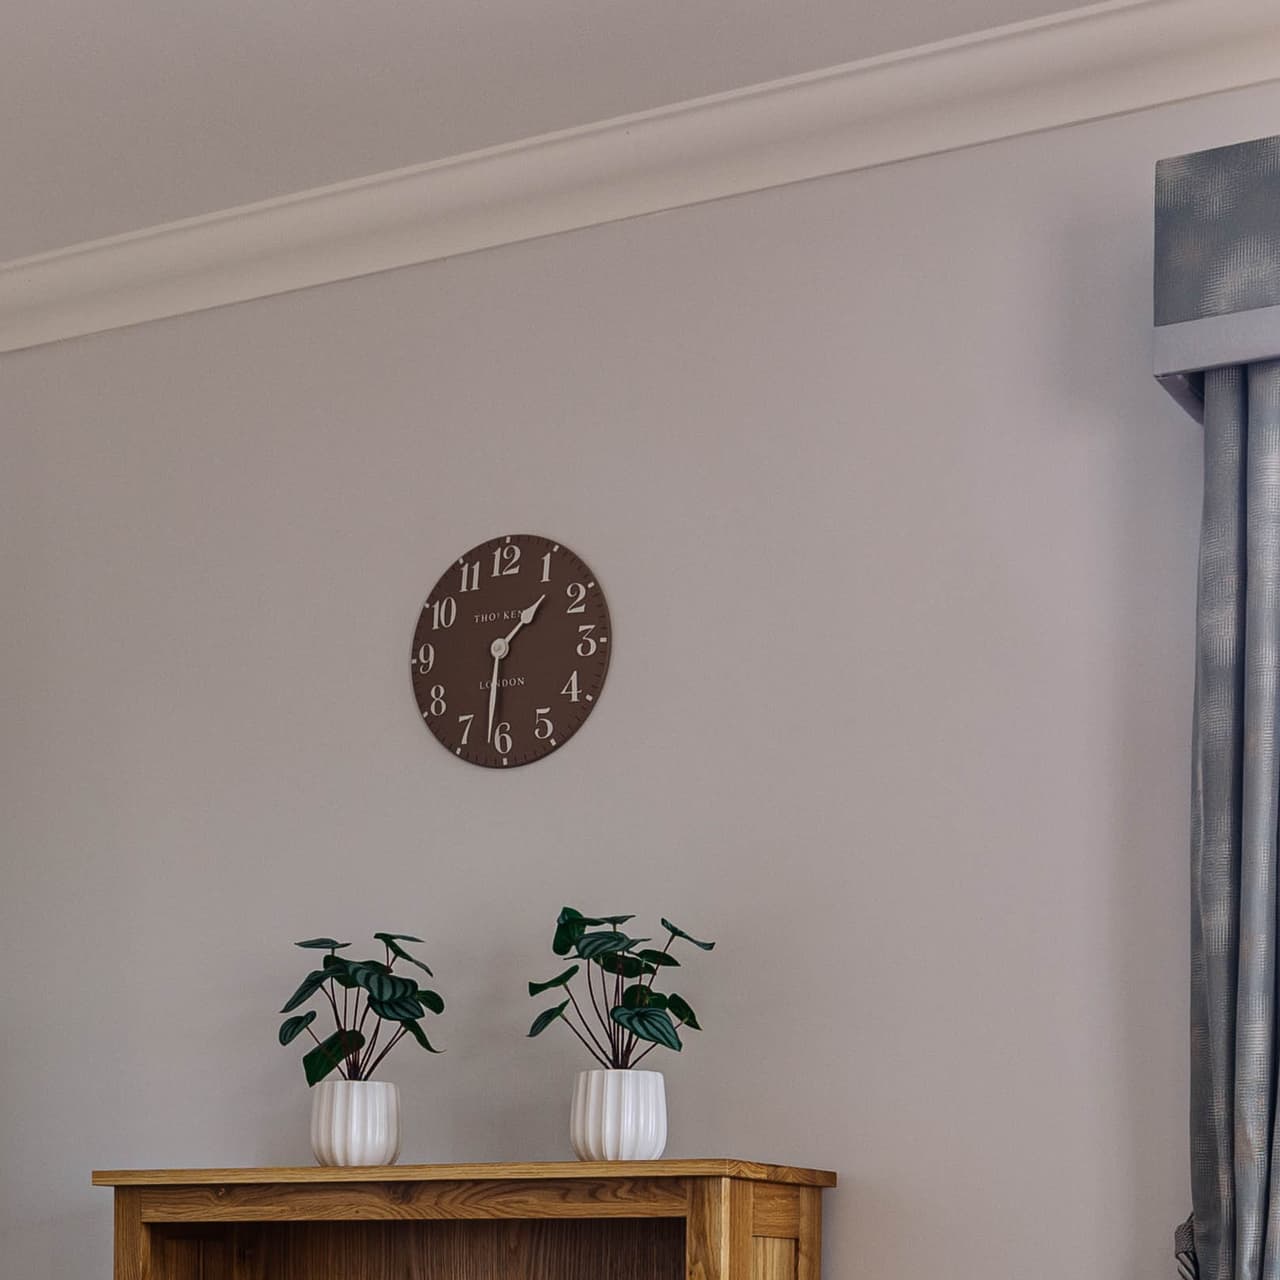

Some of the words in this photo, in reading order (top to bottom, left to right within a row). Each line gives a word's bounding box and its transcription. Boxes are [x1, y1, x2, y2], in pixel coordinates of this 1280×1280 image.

[459, 561, 481, 593] 11
[491, 544, 521, 578] 12
[540, 552, 551, 583] 1
[431, 596, 457, 630] 10
[566, 582, 586, 614] 2
[576, 625, 597, 657] 3
[418, 643, 435, 674] 9
[430, 684, 447, 716] 8
[560, 670, 582, 703] 4
[458, 714, 474, 745] 7
[494, 722, 512, 754] 6
[534, 707, 554, 740] 5
